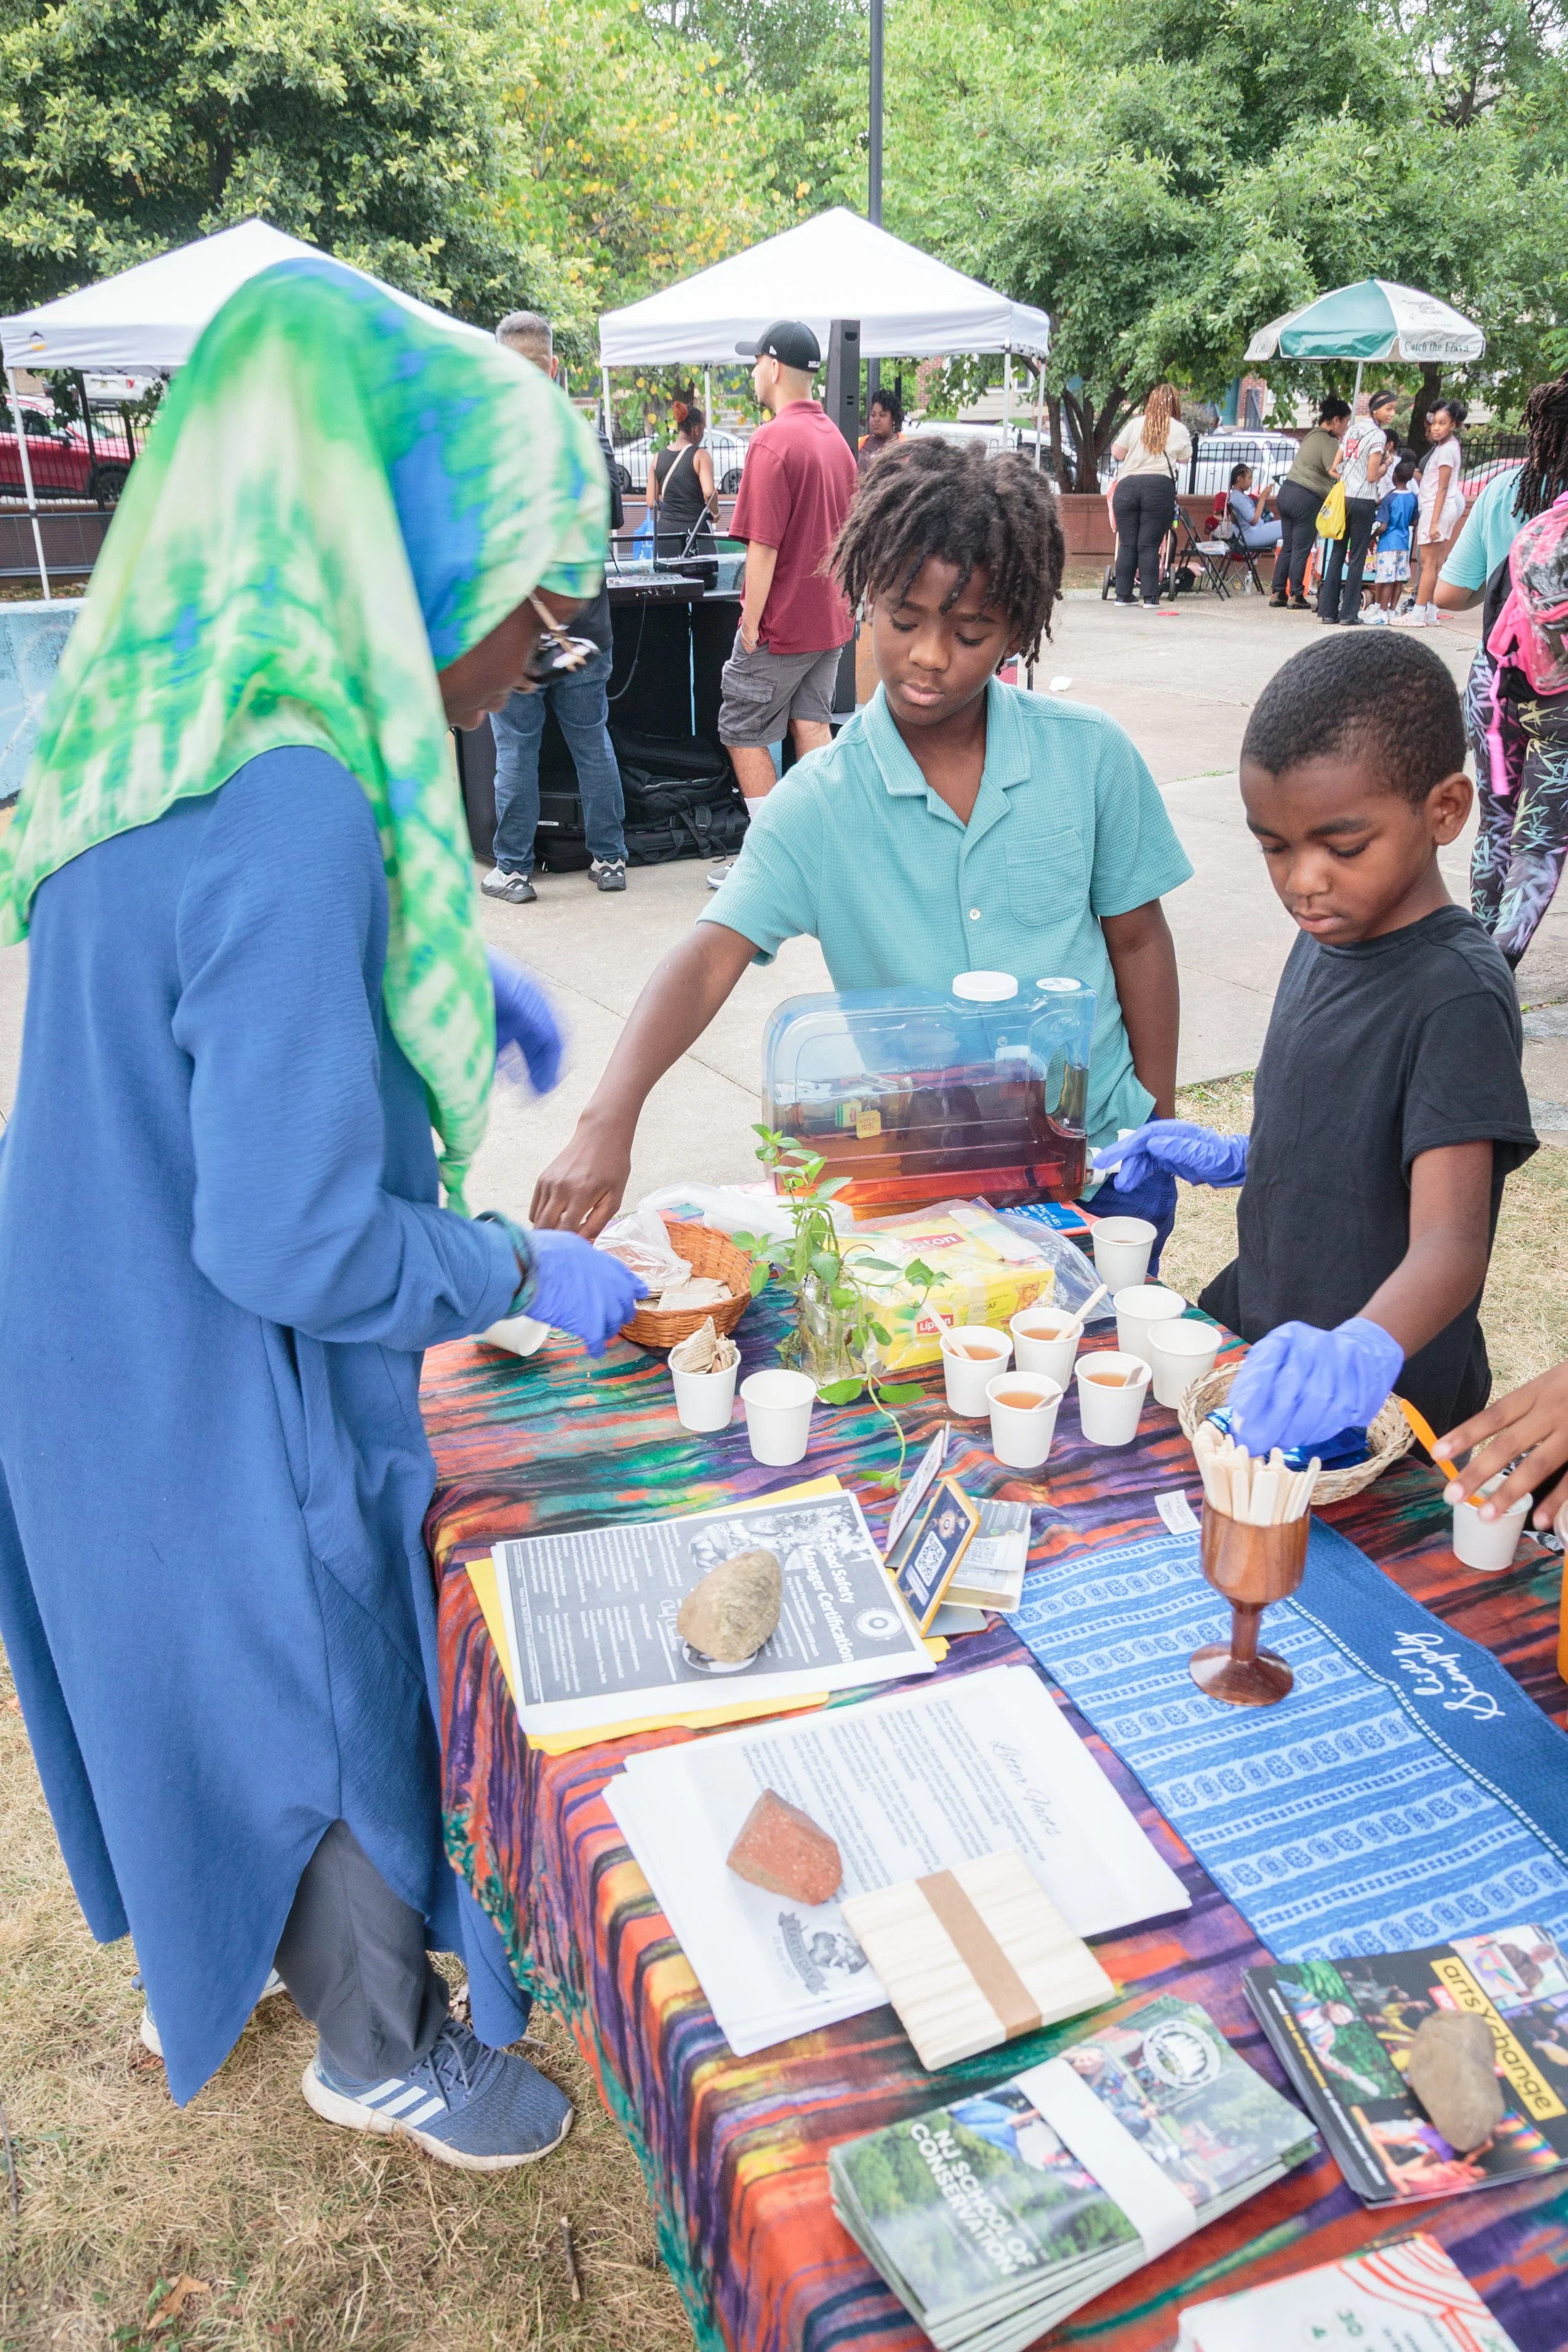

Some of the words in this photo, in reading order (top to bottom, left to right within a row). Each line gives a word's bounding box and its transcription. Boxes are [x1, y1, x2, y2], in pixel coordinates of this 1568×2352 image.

[1405, 341, 1427, 352] Catch
[1430, 342, 1442, 352] the
[657, 1599, 677, 1618] Chef
[798, 1545, 828, 1593] Manager
[817, 1591, 855, 1663] Certification
[819, 1543, 844, 1571] Food
[832, 1567, 856, 1604] Safety
[1394, 1631, 1506, 1720] Simply
[988, 1740, 1028, 1785] Litter
[1022, 1789, 1062, 1836] Facts
[787, 1924, 806, 1959] EARTH
[798, 1958, 818, 1980] DAY
[905, 2122, 1019, 2277] CONSERVATION
[930, 2127, 963, 2161] NJ
[948, 2160, 1015, 2238] SCHOOL
[1004, 2235, 1038, 2264] OF
